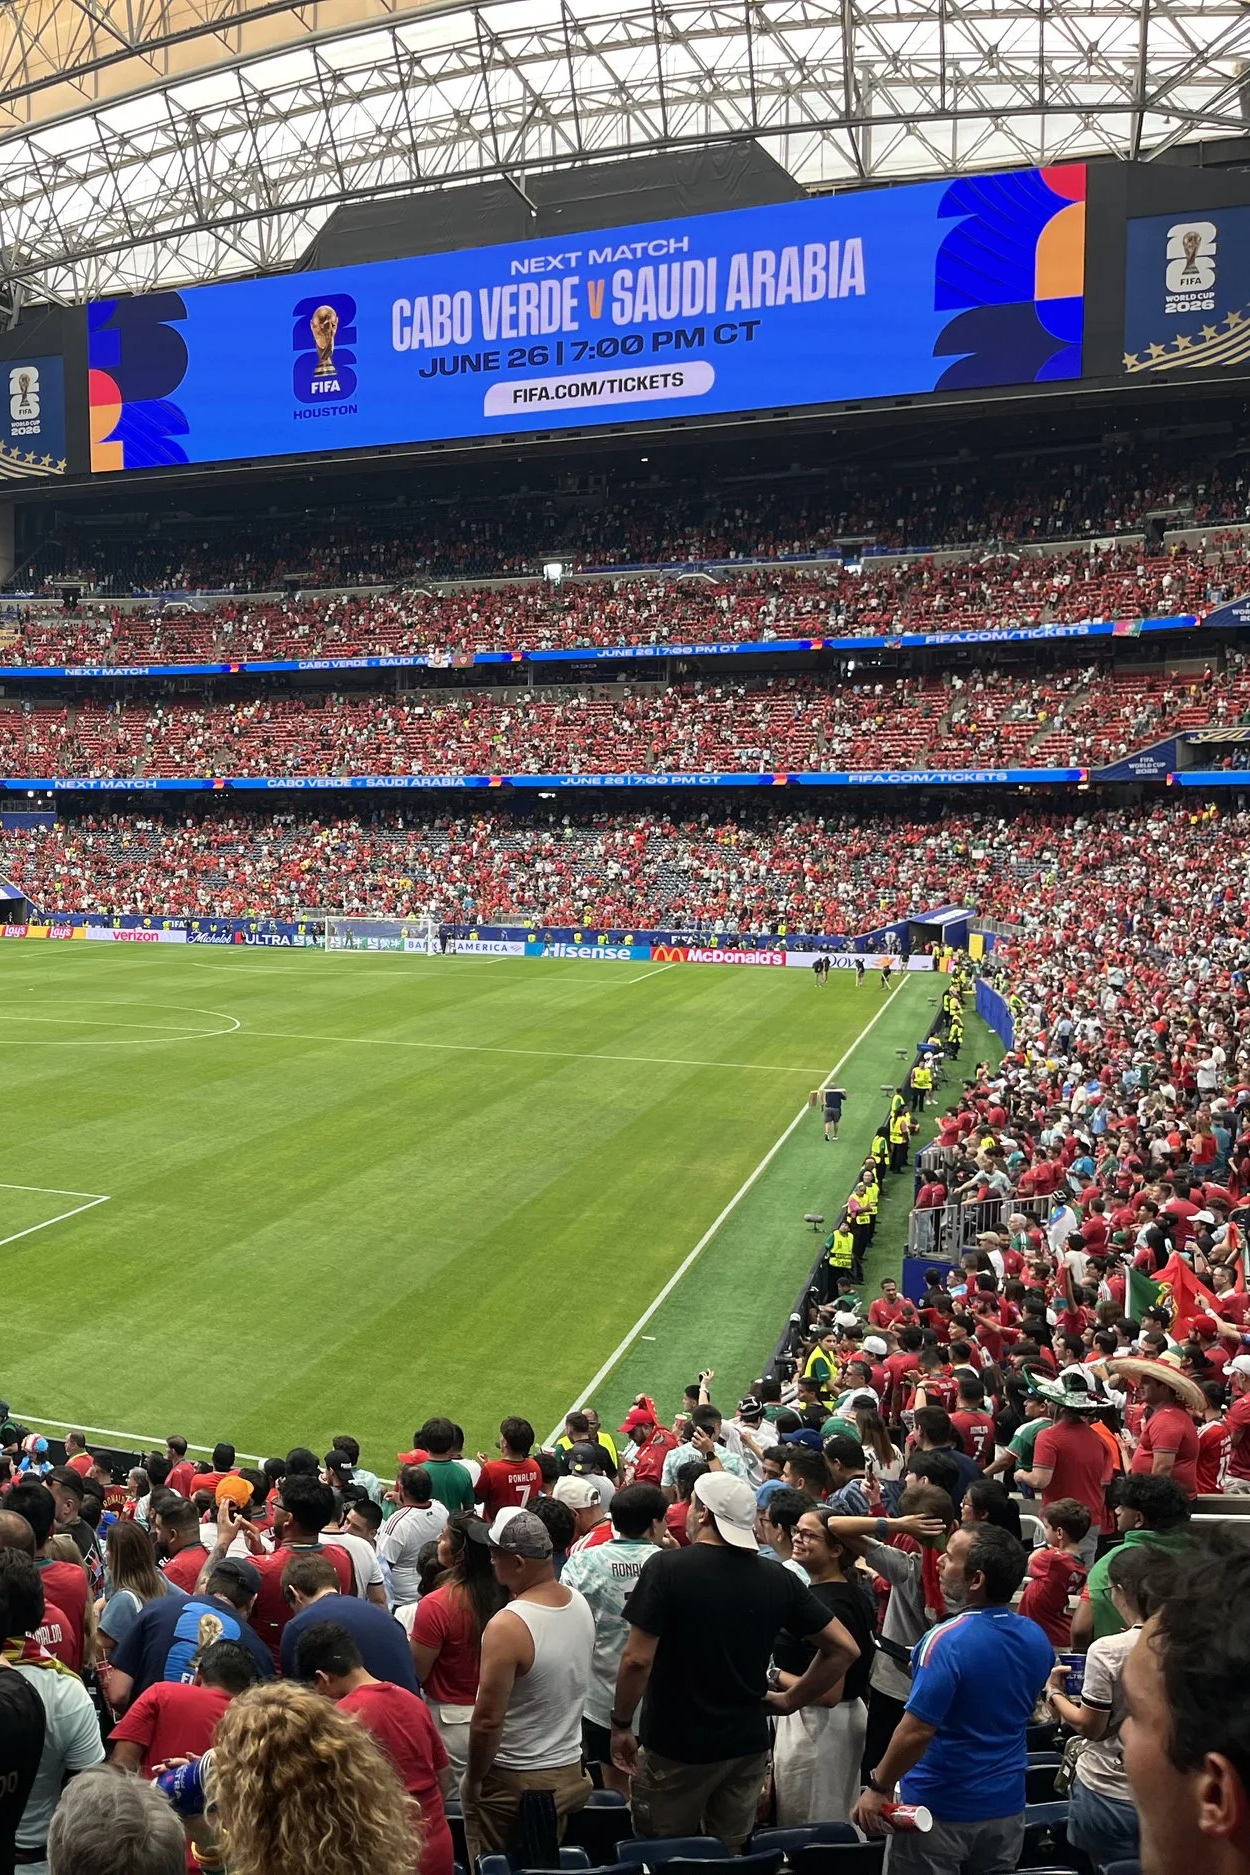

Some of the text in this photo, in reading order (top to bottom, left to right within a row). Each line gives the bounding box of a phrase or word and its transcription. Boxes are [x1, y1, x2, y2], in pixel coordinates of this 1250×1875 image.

[511, 236, 689, 276] NEXT MATCH
[1180, 277, 1202, 286] FIFA
[392, 290, 473, 352] CABO
[478, 276, 579, 341] VERDE
[612, 257, 717, 326] SAUDI
[725, 237, 866, 312] ARABIA
[1165, 292, 1215, 302] WORLD CUP
[1165, 300, 1215, 313] 2026
[418, 351, 501, 379] JUNE
[507, 345, 549, 369] 26
[570, 334, 644, 361] 7:00
[652, 327, 705, 352] PM
[713, 320, 762, 345] CT
[311, 380, 341, 394] FIFA
[513, 372, 683, 404] FIFA.COM/TICKETS
[293, 404, 358, 420] HOUSTON
[11, 426, 41, 436] 2026
[597, 649, 633, 657] JUNE
[636, 648, 653, 656] 26
[662, 647, 692, 655] 7:00
[695, 645, 717, 653] PM
[719, 645, 740, 653] CT
[298, 661, 330, 670] CABO
[331, 659, 367, 668] VERDE
[379, 658, 414, 667] SAUDI
[65, 667, 149, 676] NEXT MATCH
[267, 778, 305, 787] CABO
[310, 778, 352, 787] VERDE
[366, 778, 408, 787] SAUDI
[411, 778, 466, 787] ARABIA
[560, 776, 600, 785] JUNE
[604, 776, 625, 785] 26
[634, 776, 669, 785] 7:00
[671, 776, 696, 785] PM
[698, 776, 722, 784] CT
[849, 772, 1008, 783] FIFA.COM/TICKETS
[55, 780, 157, 789] NEXT MATCH
[5, 926, 27, 937] Lay's
[49, 927, 72, 939] Lay's
[113, 929, 159, 942] verizon
[187, 930, 232, 944] Michelob
[246, 934, 290, 945] ULTRA
[457, 943, 507, 952] AMERICA
[543, 944, 631, 960] Hisense
[687, 950, 782, 964] McDonald's
[508, 1472, 537, 1484] RONALDO
[515, 1484, 531, 1508] 7
